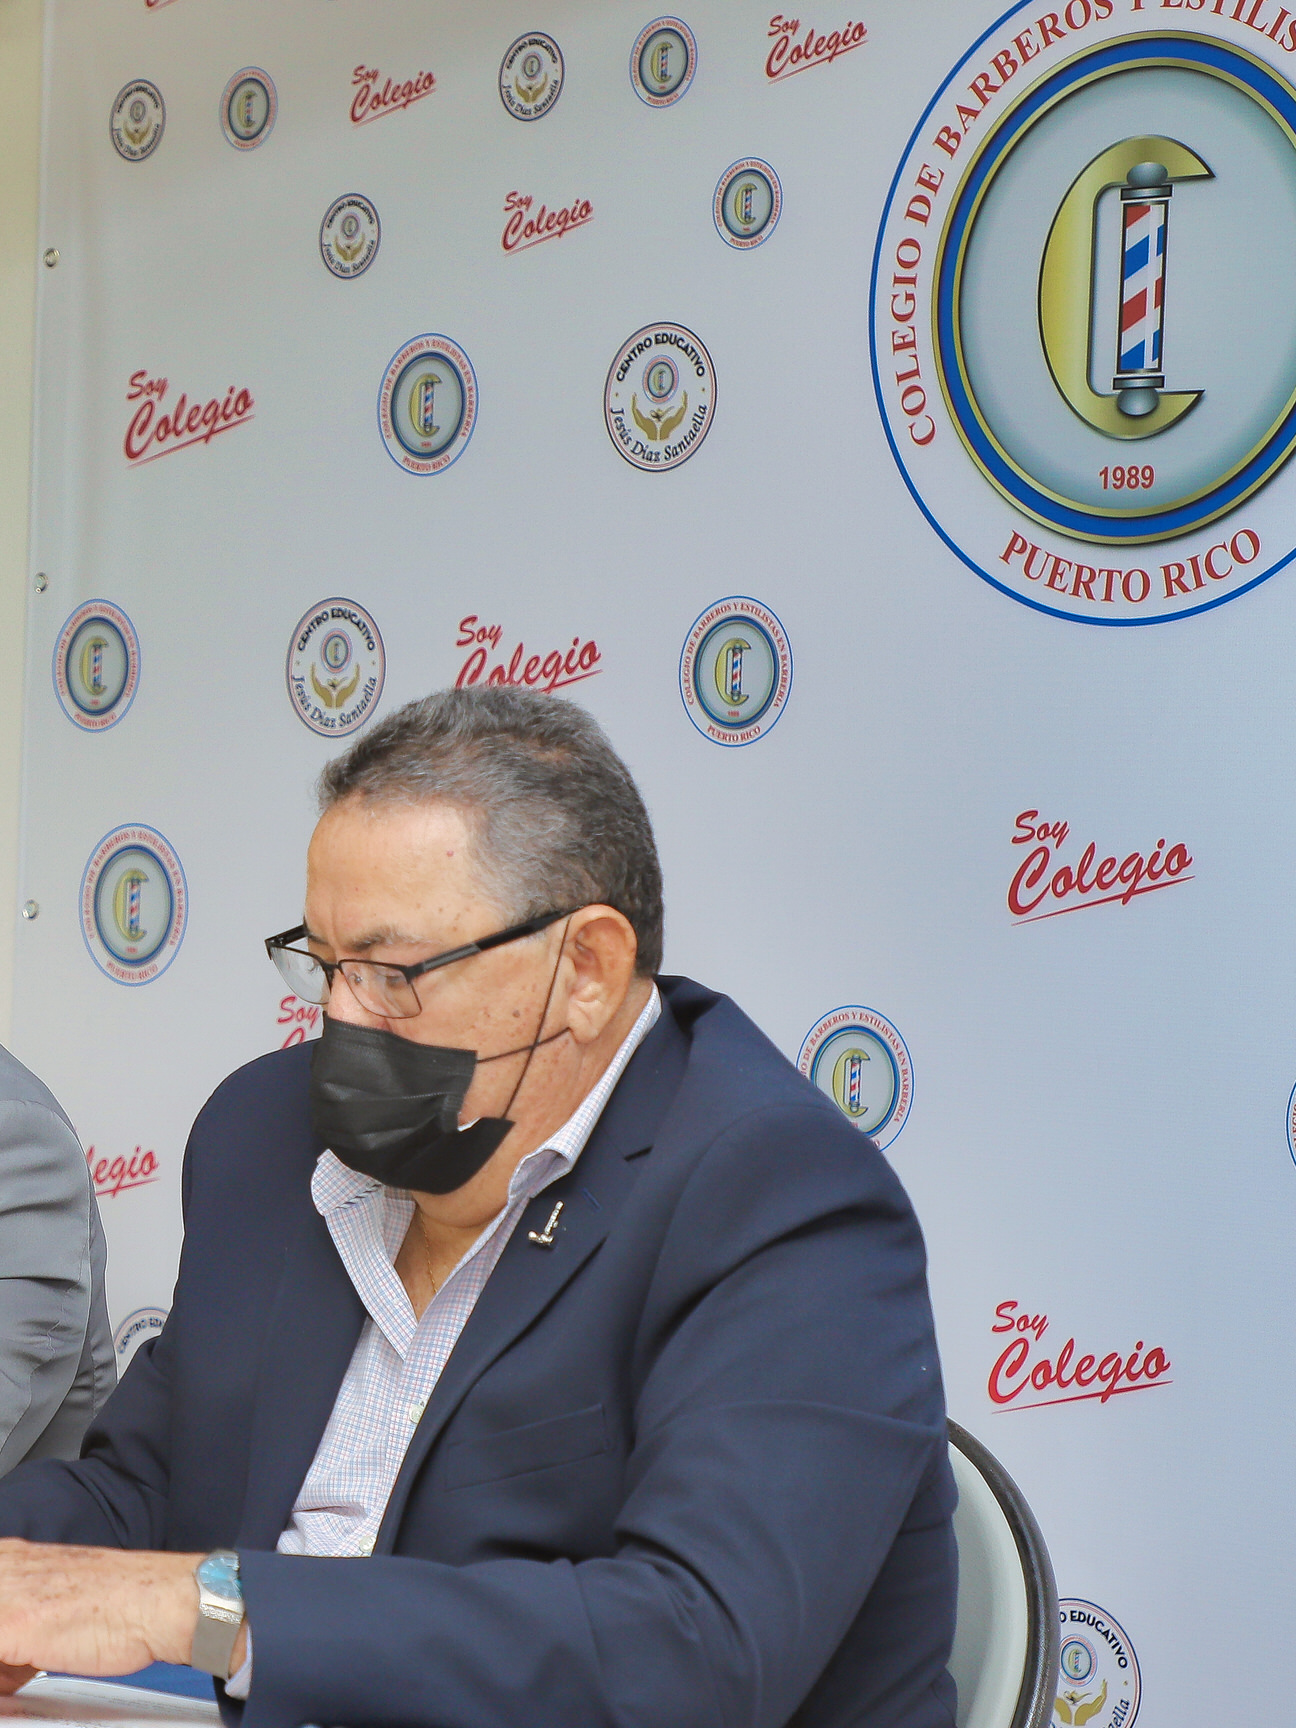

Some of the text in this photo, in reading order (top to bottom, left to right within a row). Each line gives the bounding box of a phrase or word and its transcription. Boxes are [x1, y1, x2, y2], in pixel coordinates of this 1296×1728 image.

[767, 14, 801, 36] Soy
[766, 20, 868, 78] Colegio
[350, 70, 436, 122] Colegio
[351, 64, 379, 84] Soy
[503, 190, 533, 212] Soy
[891, 0, 1113, 446] COLEGIO DE BARBEROS
[502, 198, 593, 251] Colegio
[616, 332, 706, 382] CENTRO EDUCATIVO
[126, 369, 169, 401] Soy
[124, 385, 255, 459] Colegio
[664, 404, 708, 461] Santaella
[1099, 464, 1155, 490] 1989
[999, 528, 1262, 603] PUERTO RICO
[297, 607, 376, 652] CENTRO EDUCATIVO
[456, 614, 503, 650] Soy
[693, 602, 732, 641] BARBEROS
[740, 602, 781, 638] ESTILISTAS
[707, 724, 761, 742] PUERTO RICO
[1011, 809, 1070, 850] Soy
[1007, 838, 1193, 916] Colegio
[277, 995, 321, 1029] Soy
[810, 1011, 850, 1046] BARBEROS
[859, 1012, 900, 1051] ESTILISTAS
[86, 1144, 160, 1198] legio
[991, 1300, 1050, 1342] Soy
[987, 1337, 1171, 1405] Colegio
[1070, 1609, 1128, 1669] EDUCATIVO
